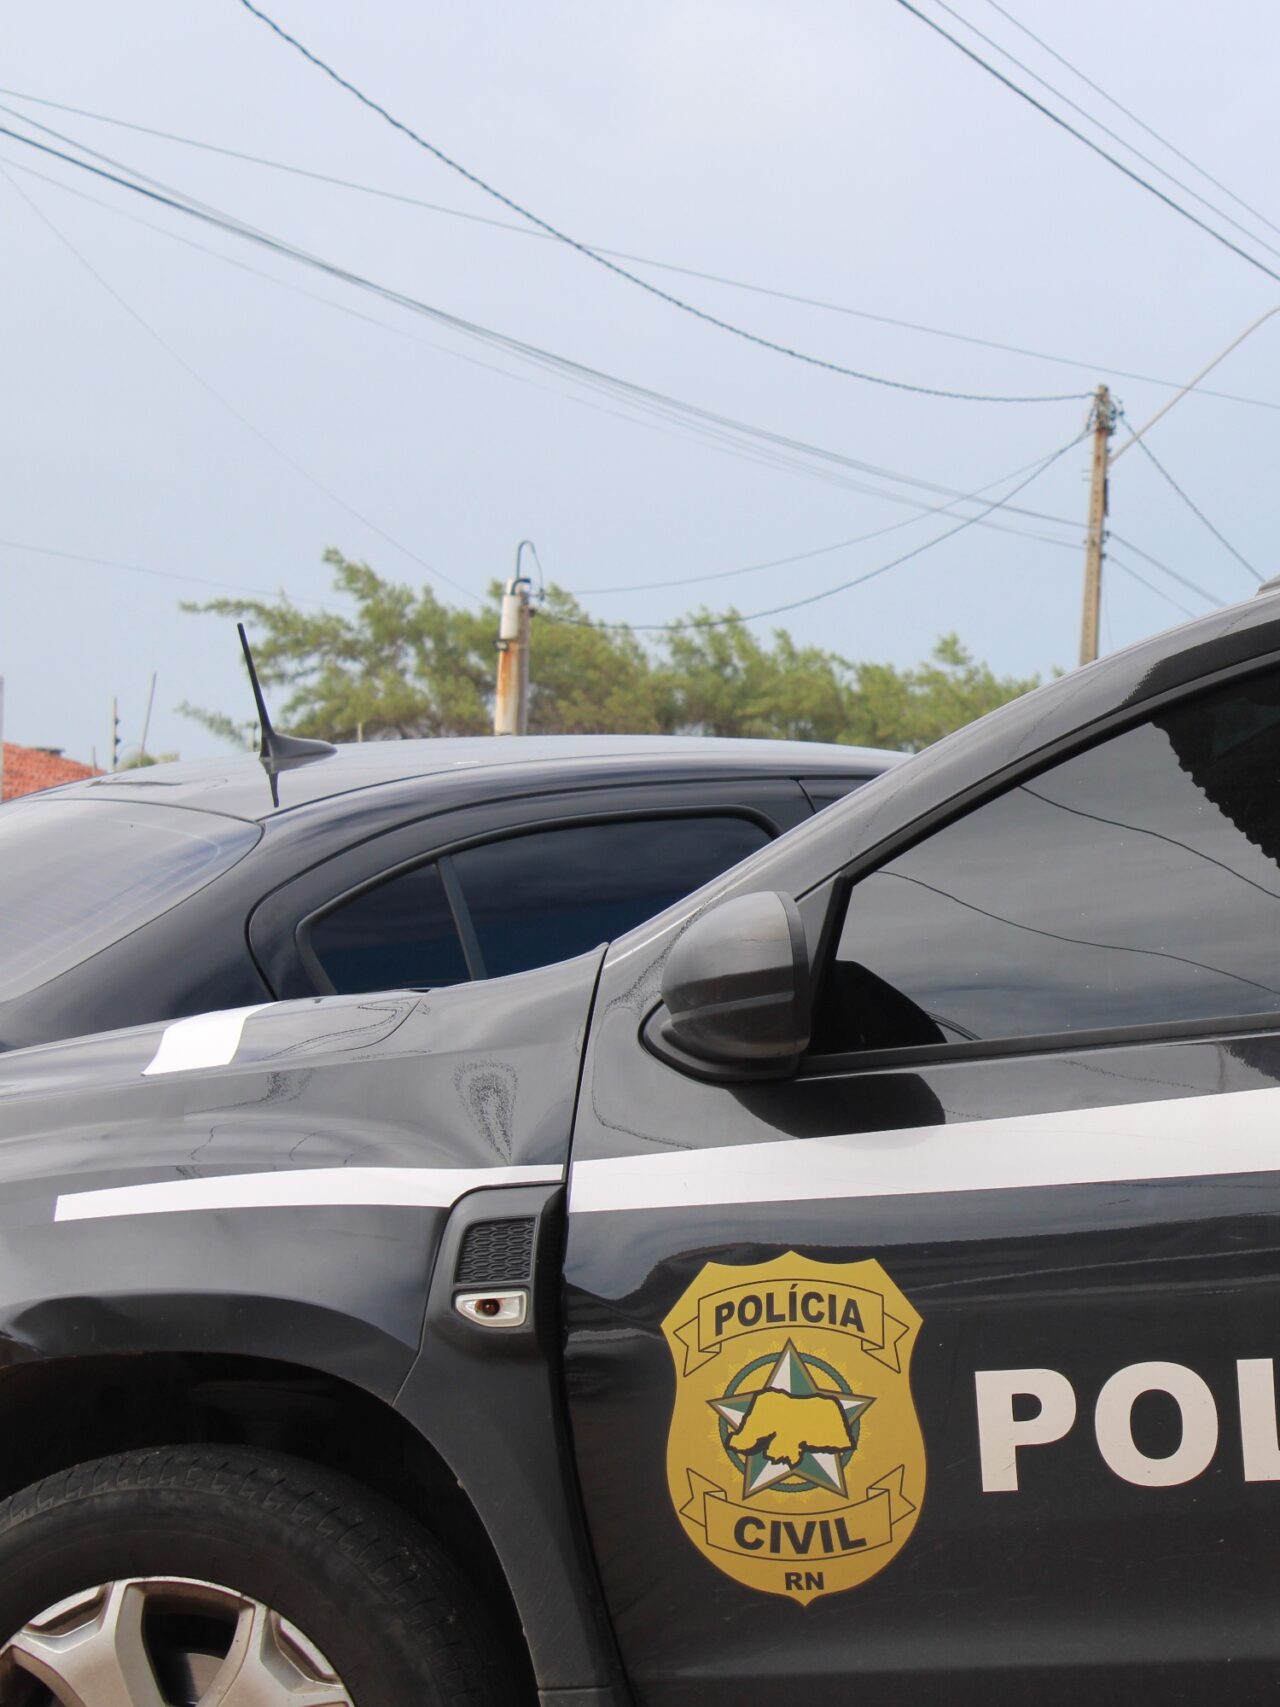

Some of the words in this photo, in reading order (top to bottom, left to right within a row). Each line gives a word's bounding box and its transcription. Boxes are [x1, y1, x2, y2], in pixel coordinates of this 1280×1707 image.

[714, 1283, 866, 1337] POLÍCIA
[733, 1515, 868, 1555] CIVIL
[784, 1571, 825, 1591] RN
